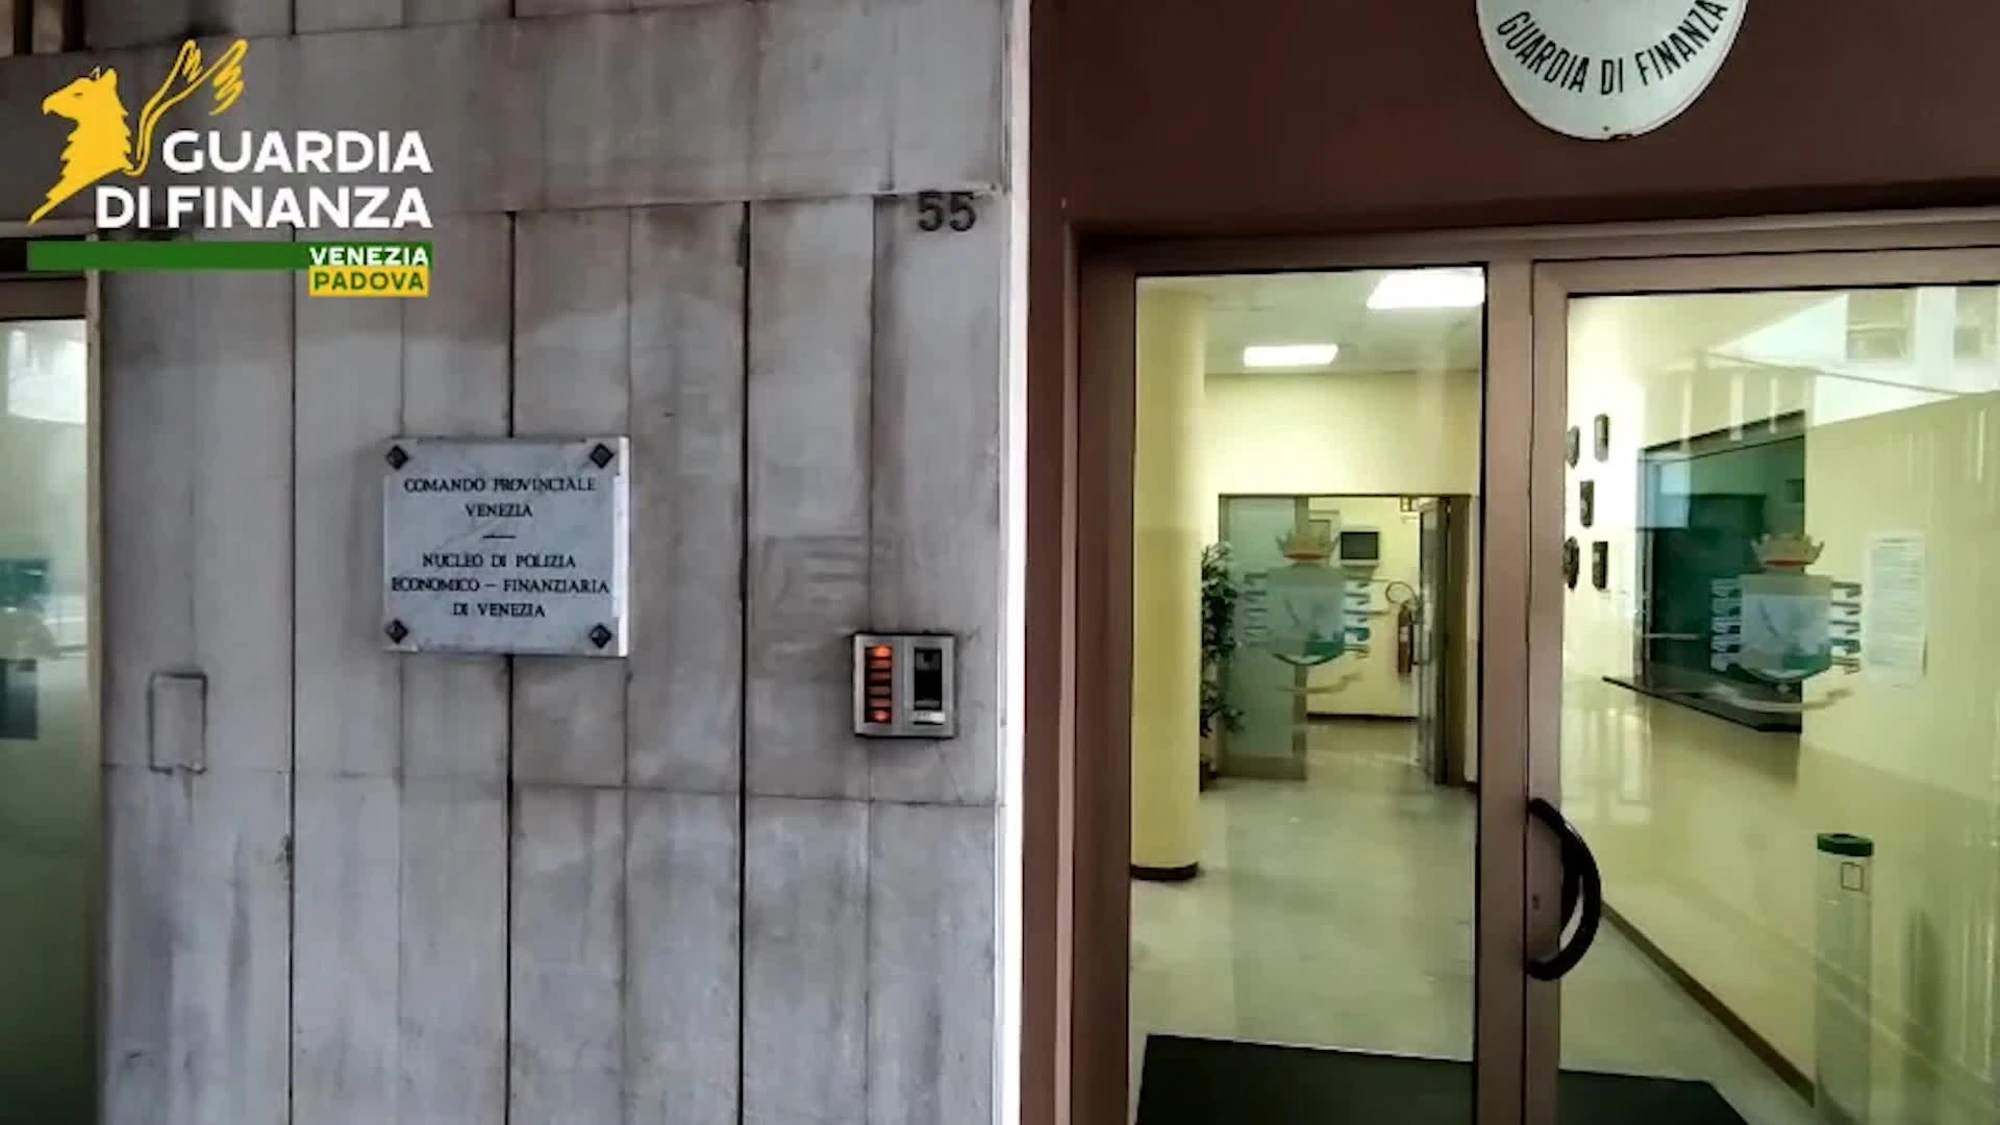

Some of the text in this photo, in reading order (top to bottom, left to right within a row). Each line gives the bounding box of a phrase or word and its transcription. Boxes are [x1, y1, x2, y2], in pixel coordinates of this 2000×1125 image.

[1496, 0, 1728, 95] GUARDIA DI FINANZA
[917, 190, 976, 232] 55
[404, 477, 597, 493] COMANDO PROVINCIALE
[465, 503, 533, 518] VENEZIA
[422, 554, 576, 568] NUCLEO DI POLIZIA
[391, 577, 480, 592] ECONOMICO
[503, 579, 610, 594] FINANZIARIA
[453, 603, 546, 618] DI VENEZIA
